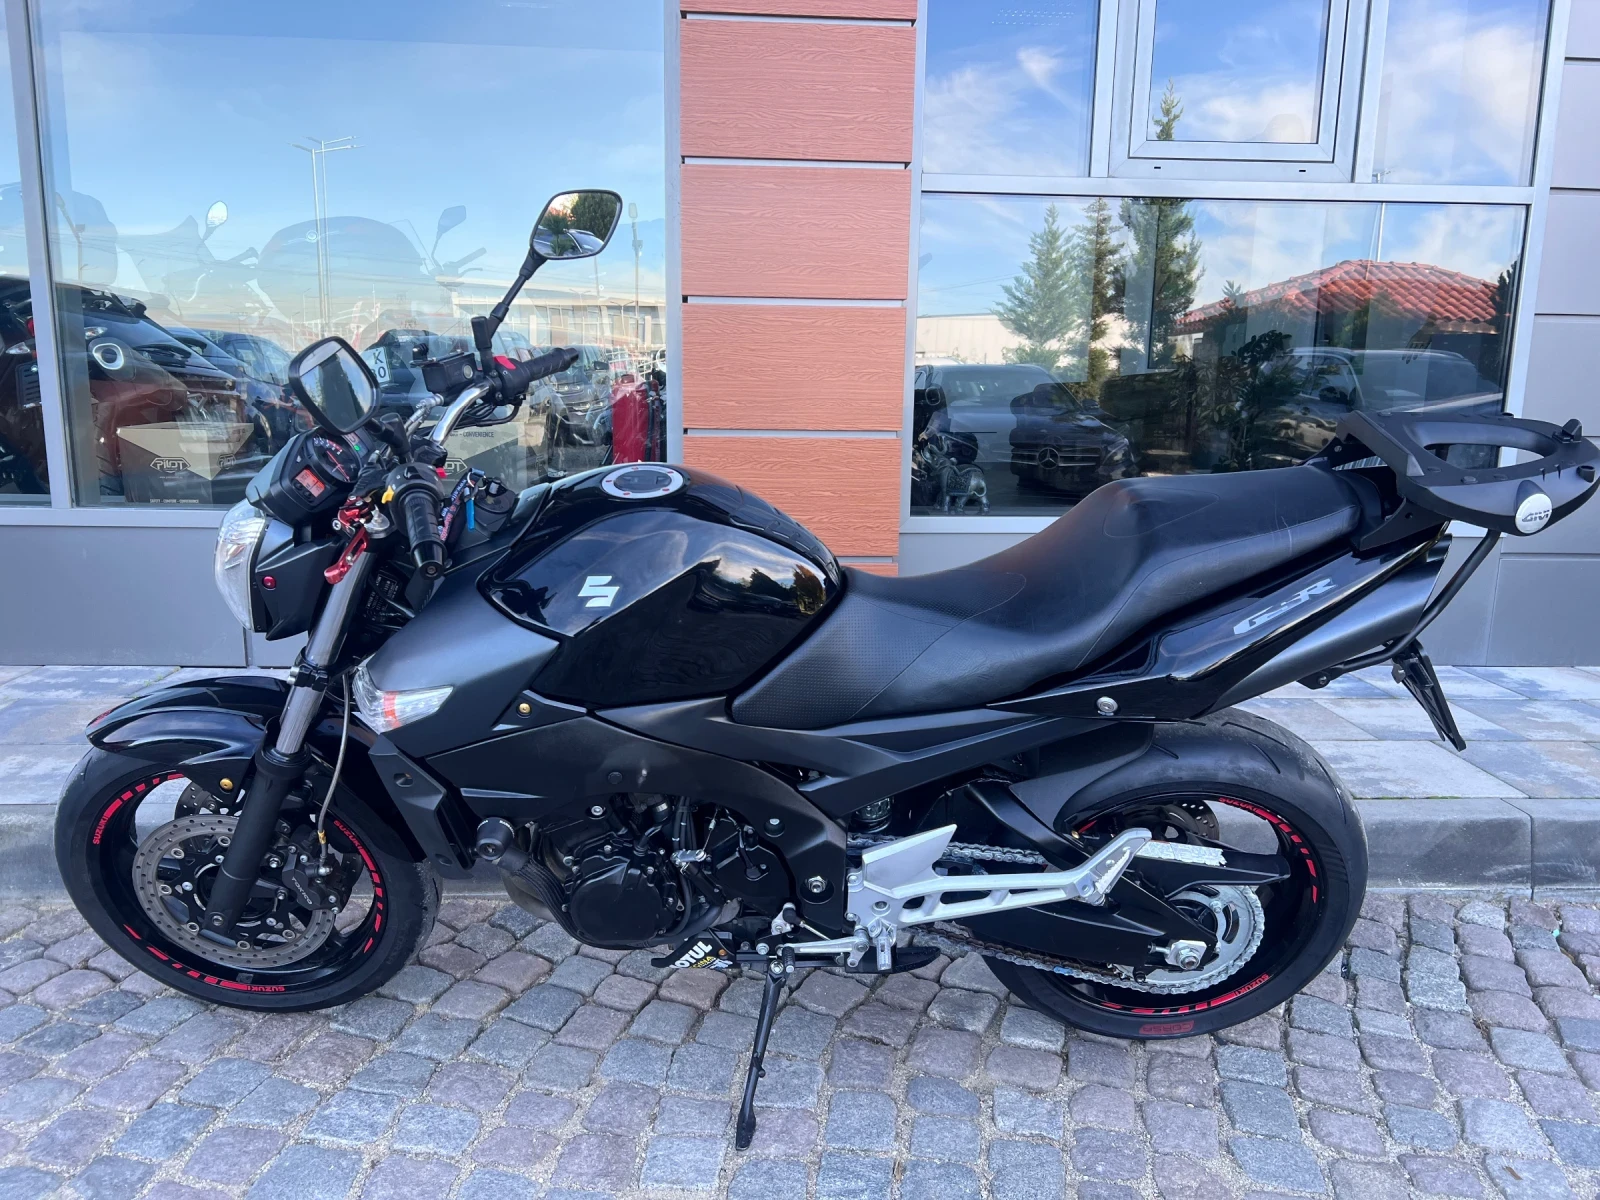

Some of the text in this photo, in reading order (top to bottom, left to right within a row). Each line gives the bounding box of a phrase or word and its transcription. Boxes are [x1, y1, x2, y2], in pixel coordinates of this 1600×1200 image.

[1522, 510, 1550, 523] GIVI
[1218, 797, 1258, 813] SUZUKI
[92, 815, 109, 845] SUZUKI
[333, 819, 363, 850] SUZUKI
[291, 876, 313, 905] TOKICO
[1234, 972, 1270, 997] SUZUKI
[1142, 1022, 1193, 1033] CORSA
